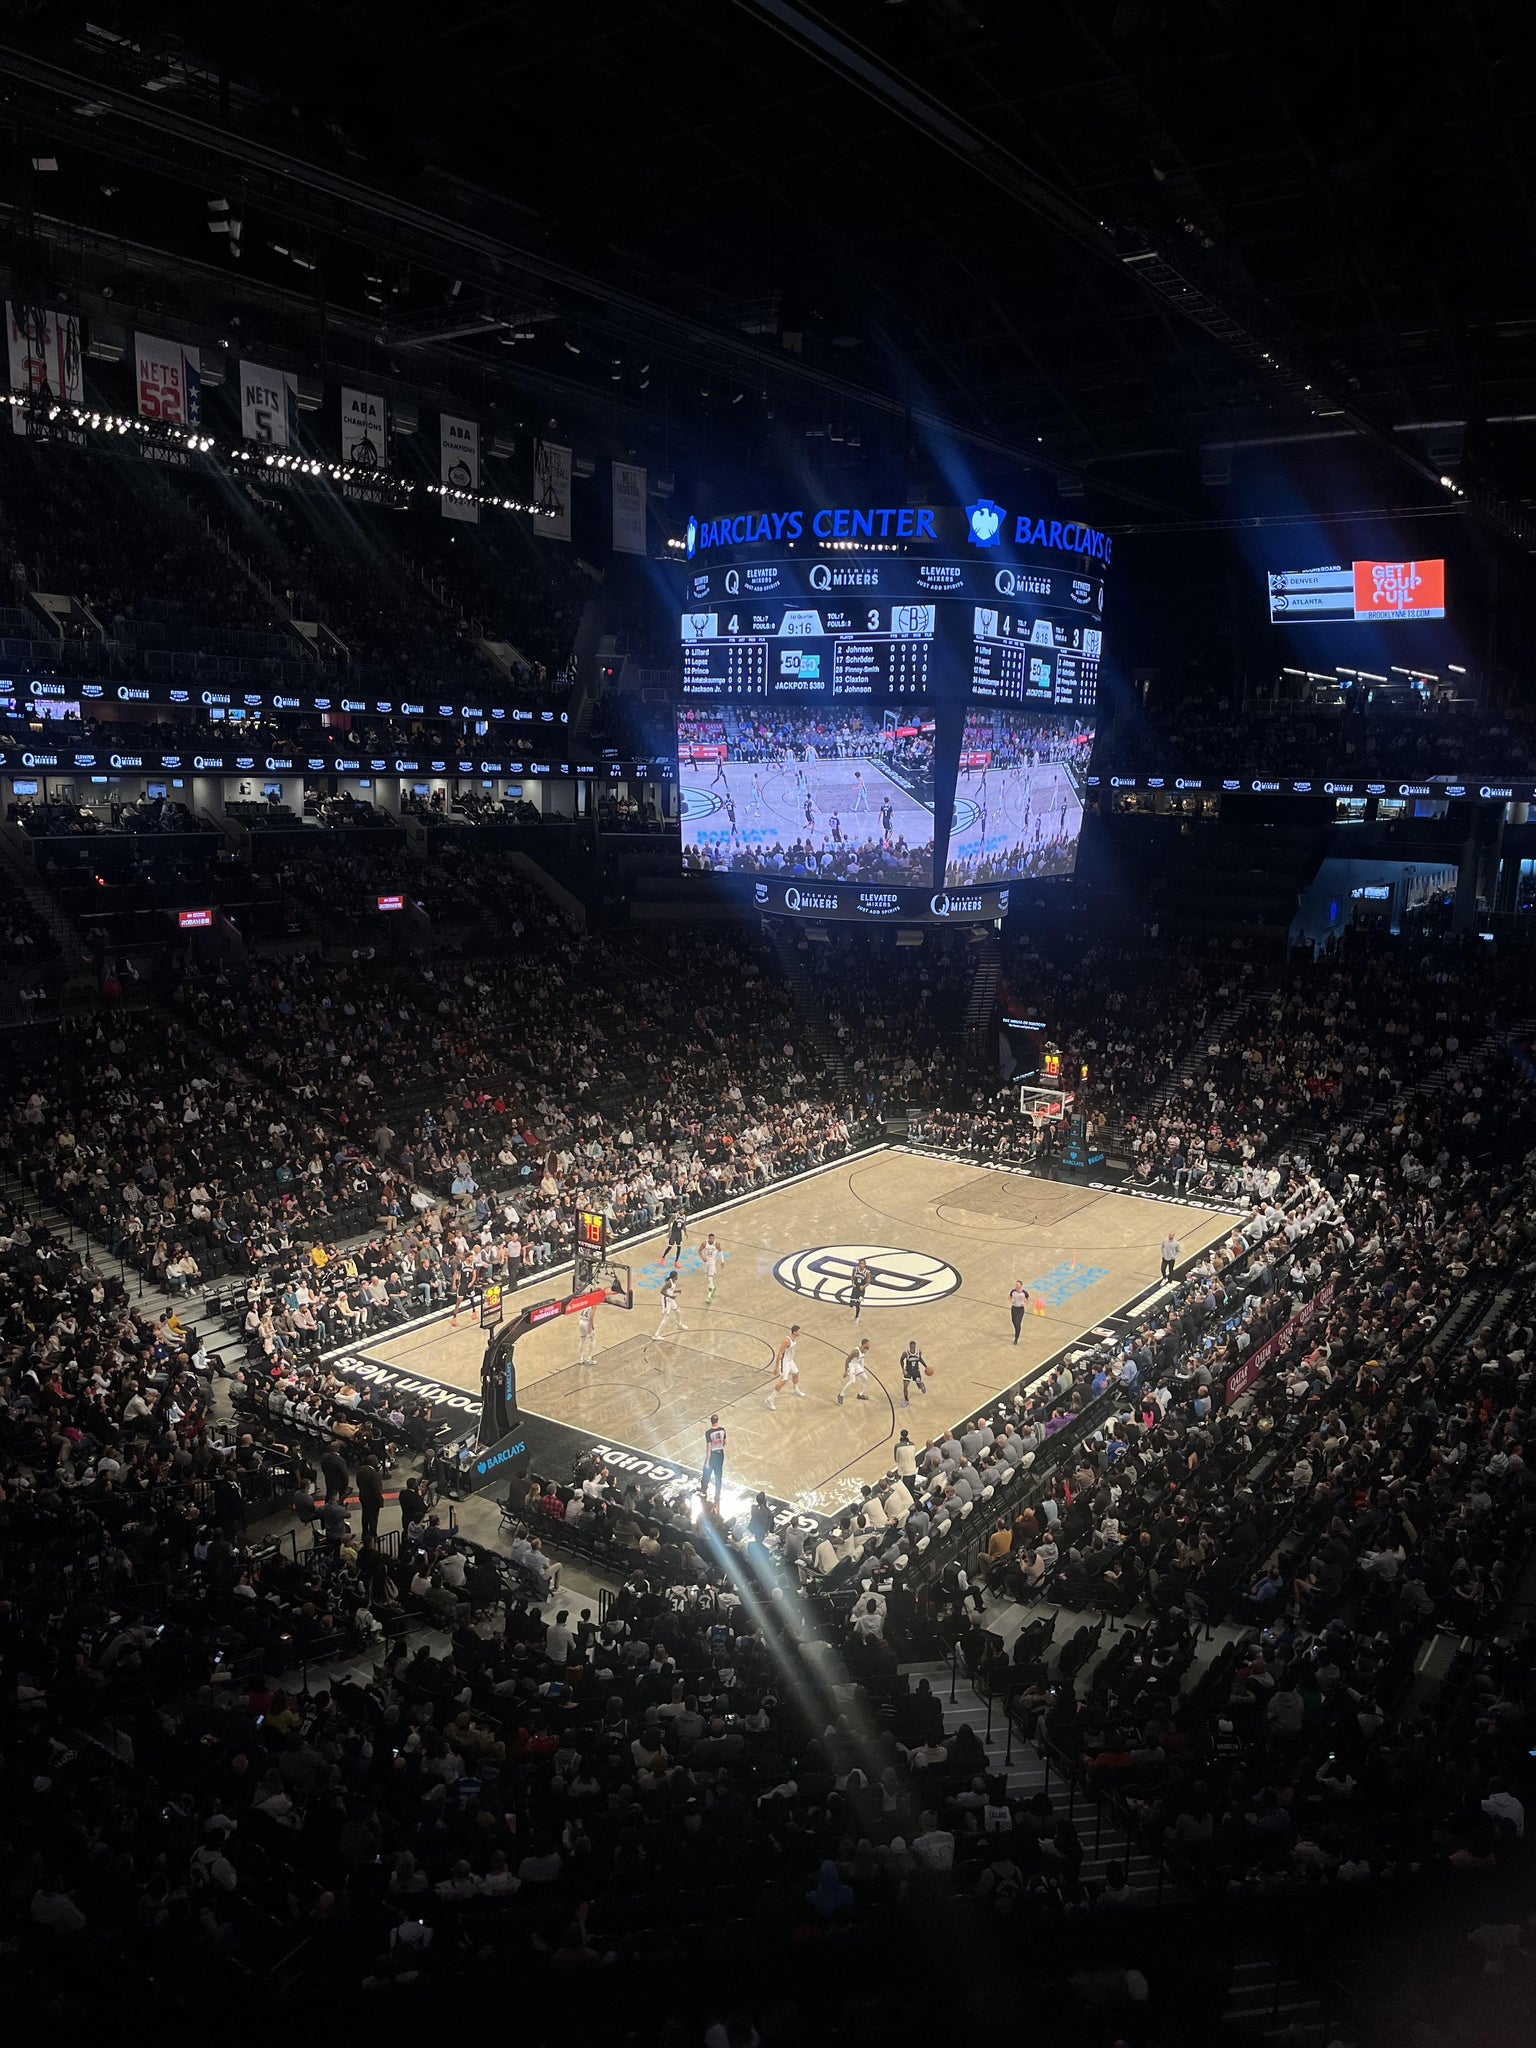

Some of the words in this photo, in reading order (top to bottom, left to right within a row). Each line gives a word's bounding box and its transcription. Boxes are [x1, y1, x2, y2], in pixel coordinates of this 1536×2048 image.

[140, 359, 179, 387] NETS
[140, 381, 181, 423] 52
[246, 385, 279, 413] NETS
[352, 400, 376, 417] ABA
[255, 409, 273, 442] 5
[344, 416, 382, 432] CHAMPIONS
[450, 426, 471, 441] ABA
[442, 440, 476, 455] CHAMPIONS
[700, 510, 803, 550] BARCLAYS
[813, 508, 938, 539] CENTER
[1014, 516, 1104, 559] BARCLAYS
[746, 568, 778, 579] ELEVATED
[810, 564, 832, 592] Q
[920, 566, 961, 576] ELEVATED
[1372, 564, 1405, 578] GET
[725, 570, 739, 595] Q
[833, 574, 879, 586] MIXERS
[916, 580, 930, 589] JUST
[944, 580, 964, 591] SPIRITS
[994, 570, 1015, 596] Q
[1016, 579, 1050, 595] MIXERS
[1292, 598, 1323, 606] ATLANTA
[868, 610, 880, 631] 3
[1368, 610, 1430, 619] BROOKLYNNETS.COM
[728, 614, 739, 634] 4
[788, 622, 812, 635] 9:16
[1003, 616, 1010, 636] 4
[1073, 629, 1080, 648] 3
[785, 656, 801, 668] 50
[836, 656, 844, 664] 17
[845, 656, 874, 664] Schröder
[30, 681, 43, 695] Q
[117, 686, 129, 700] Q
[775, 682, 809, 690] JACKPOT:
[202, 691, 212, 705] Q
[273, 696, 283, 708] Q
[341, 700, 351, 712] Q
[22, 753, 35, 767] Q
[110, 755, 122, 768] Q
[194, 756, 204, 769] Q
[266, 758, 276, 770] Q
[1110, 777, 1120, 787] Q
[1175, 778, 1185, 789] Q
[1252, 780, 1262, 792] Q
[1324, 782, 1334, 794] Q
[1399, 784, 1410, 796] Q
[1480, 786, 1491, 798] Q
[785, 887, 801, 911] Q
[802, 897, 838, 909] MIXERS
[860, 893, 898, 902] ELEVATED
[856, 906, 868, 914] JUST
[882, 905, 901, 915] SPIRITS
[930, 893, 950, 917] Q
[951, 900, 982, 912] MIXERS
[1047, 1062, 1057, 1074] 18
[890, 1144, 979, 1165] Brooklyn
[981, 1162, 1032, 1175] Nets
[1062, 1159, 1084, 1167] BARCLAYS
[1088, 1182, 1130, 1193] GET
[1130, 1190, 1189, 1204] YOUR
[1190, 1201, 1253, 1217] GUIDE
[584, 1213, 602, 1227] 9:16
[586, 1224, 600, 1242] 18
[1320, 1284, 1334, 1304] QATAR
[1300, 1302, 1314, 1323] QATAR
[1254, 1344, 1272, 1368] QATAR
[334, 1357, 399, 1385] Nets
[1230, 1366, 1249, 1391] QATAR
[394, 1376, 483, 1415] ooklyn
[487, 1442, 526, 1470] BARCLAYS
[592, 1444, 675, 1481] GUIDE
[774, 1509, 819, 1533] GE
[671, 1599, 685, 1612] 34
